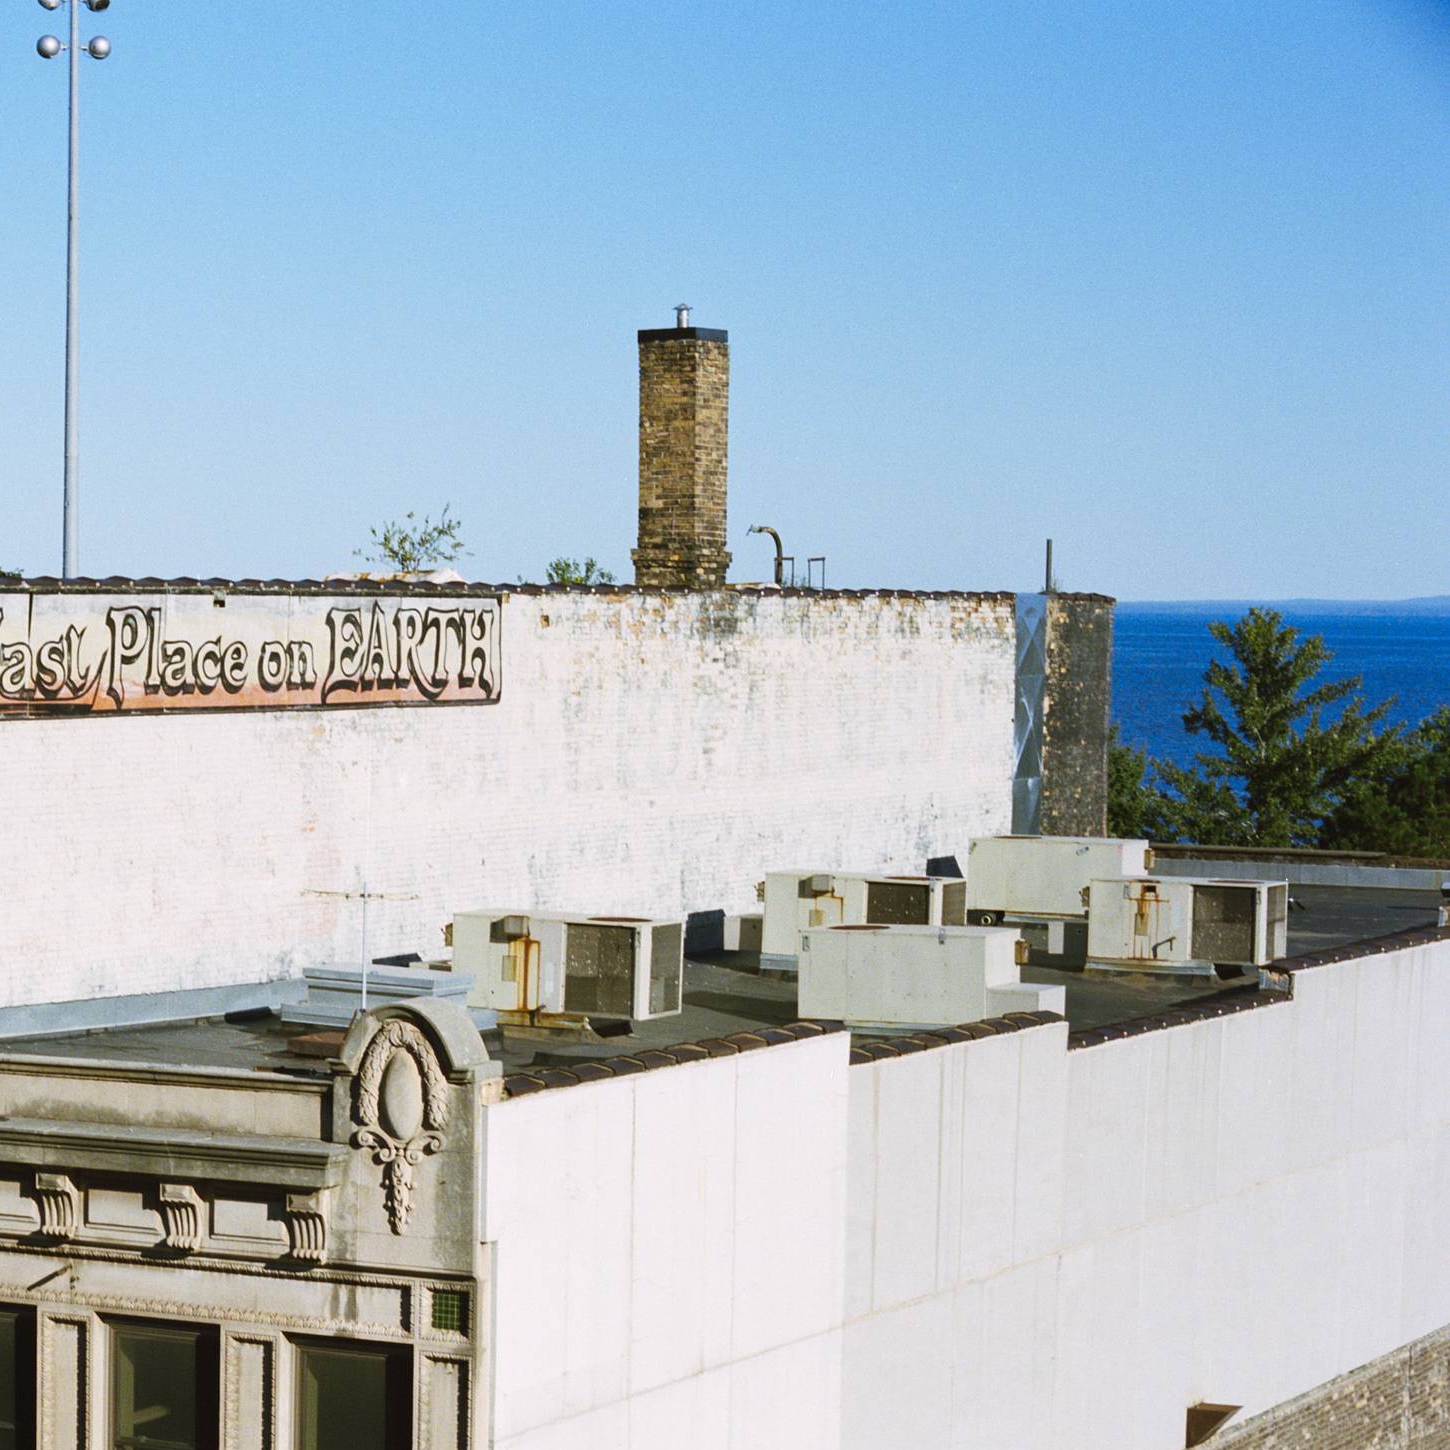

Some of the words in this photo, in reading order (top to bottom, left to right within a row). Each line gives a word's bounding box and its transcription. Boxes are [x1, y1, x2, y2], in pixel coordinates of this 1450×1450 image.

[106, 606, 249, 711] Place
[258, 640, 317, 692] on
[321, 600, 495, 705] EARTH
